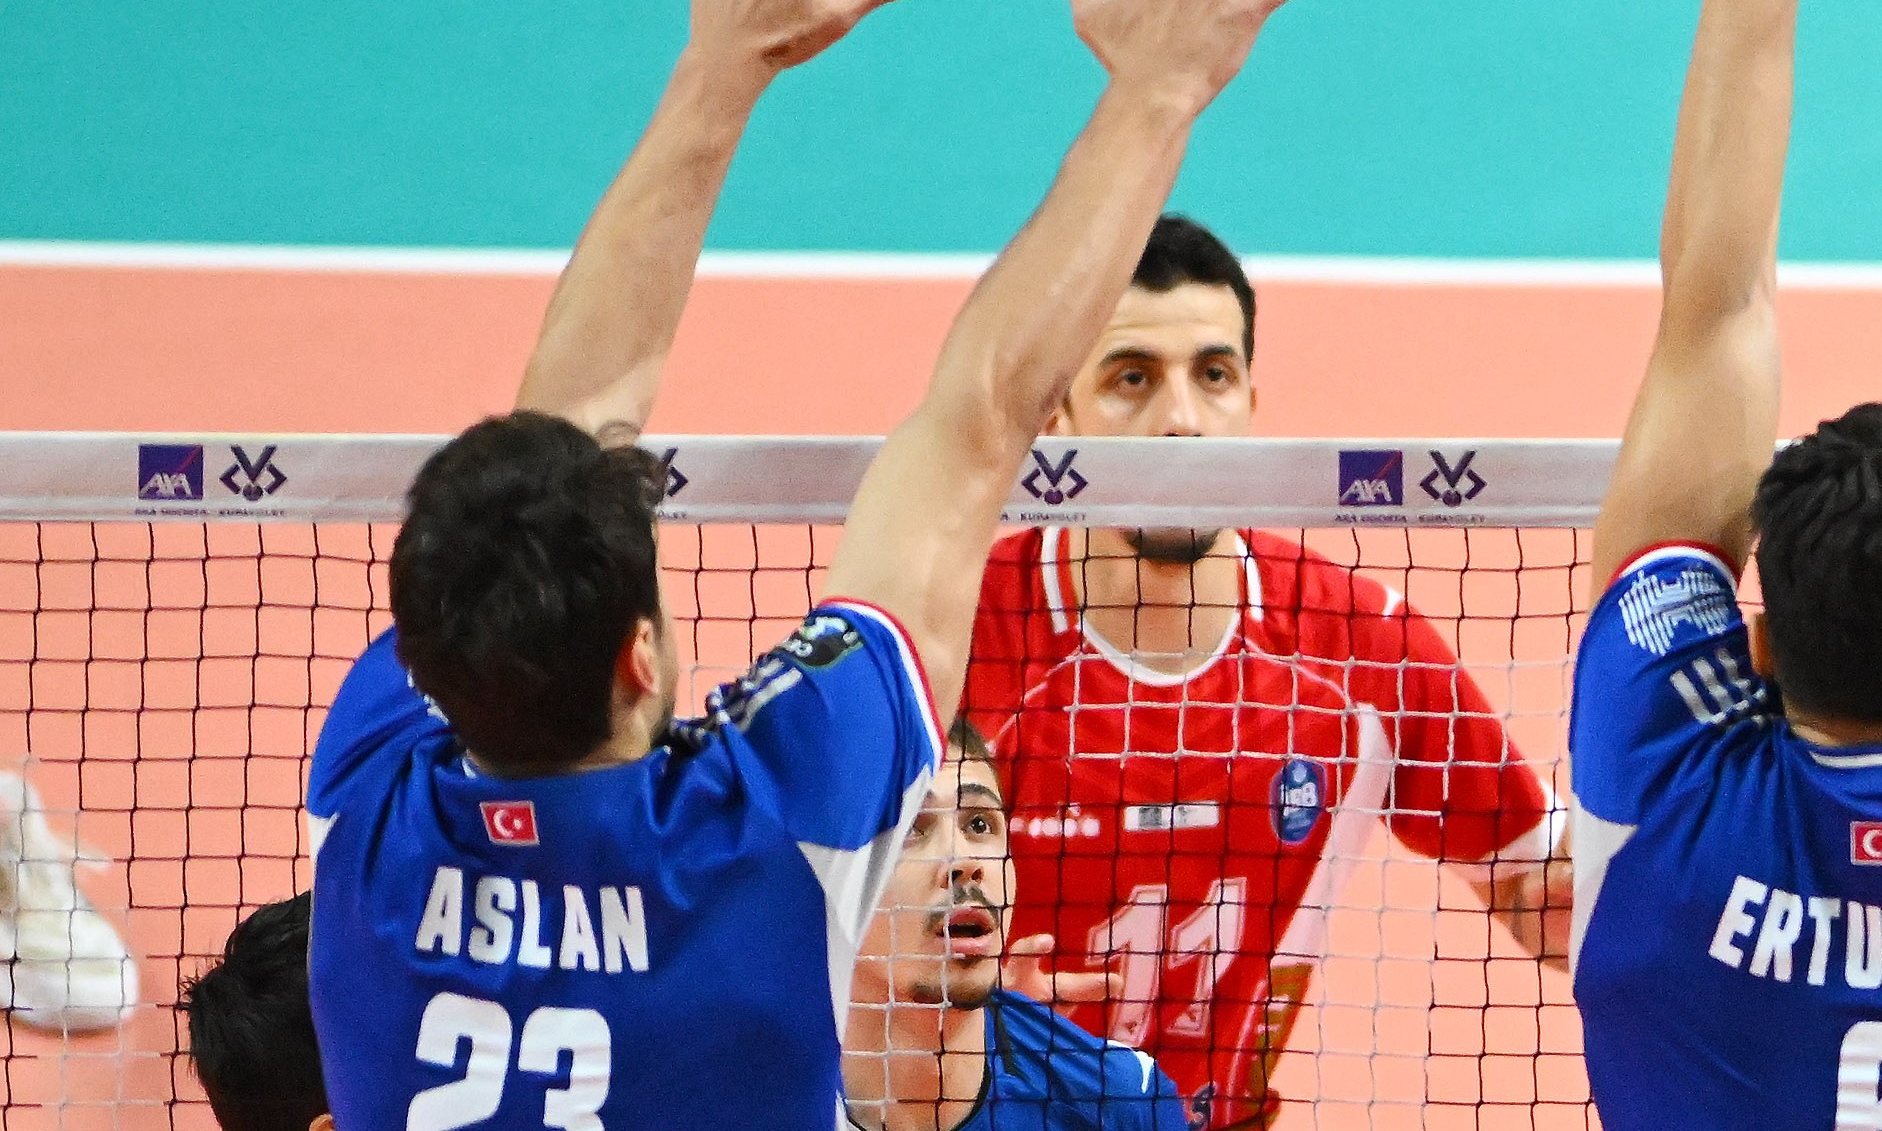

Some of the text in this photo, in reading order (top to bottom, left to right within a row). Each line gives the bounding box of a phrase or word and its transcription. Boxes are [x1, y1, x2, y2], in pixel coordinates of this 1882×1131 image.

[1338, 479, 1392, 502] AXA
[415, 866, 650, 974] ASLAN
[1086, 877, 1247, 1045] 11
[405, 992, 612, 1131] 23
